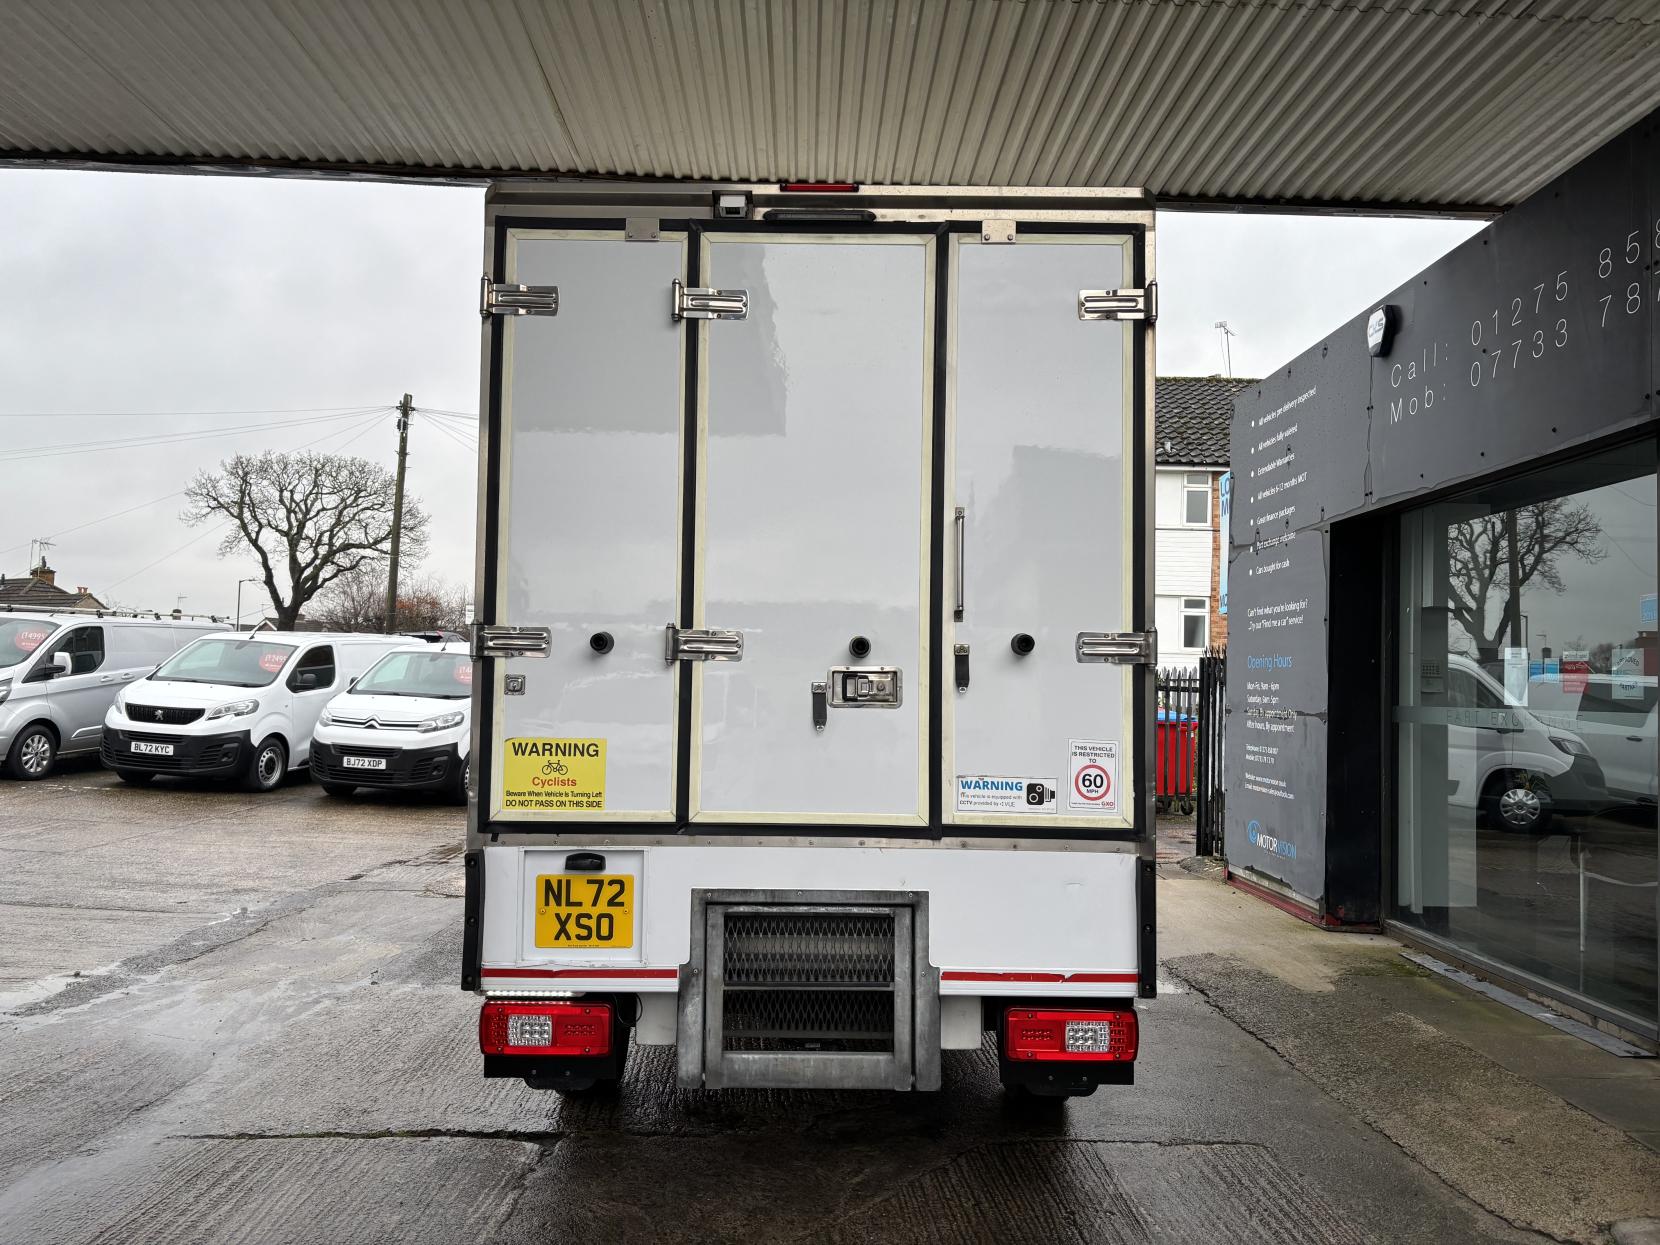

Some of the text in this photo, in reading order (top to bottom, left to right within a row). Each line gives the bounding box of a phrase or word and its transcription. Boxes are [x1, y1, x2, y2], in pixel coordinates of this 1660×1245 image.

[1391, 342, 1448, 388] Call:
[1471, 270, 1568, 346] 01275
[1390, 383, 1446, 425] Mob:
[1470, 318, 1568, 387] 07733
[1264, 410, 1277, 424] vehicles
[1263, 436, 1276, 448] vehicles
[1298, 471, 1307, 484] MOT
[1279, 505, 1296, 519] packages
[1284, 601, 1300, 613] looking
[1247, 652, 1292, 672] Opening Hours
[134, 742, 170, 754] BL72 KYC
[511, 741, 600, 758] WARNING
[1078, 751, 1115, 759] RESTRICTED
[346, 757, 383, 768] BJ72 XDP
[531, 776, 577, 788] Cyclists
[960, 780, 1023, 791] WARNING
[1081, 773, 1104, 789] 60
[570, 791, 591, 799] Turning
[505, 799, 603, 808] DO NOT PASS ON THIS SIDE
[544, 878, 625, 907] NL72
[553, 912, 614, 941] XSO
